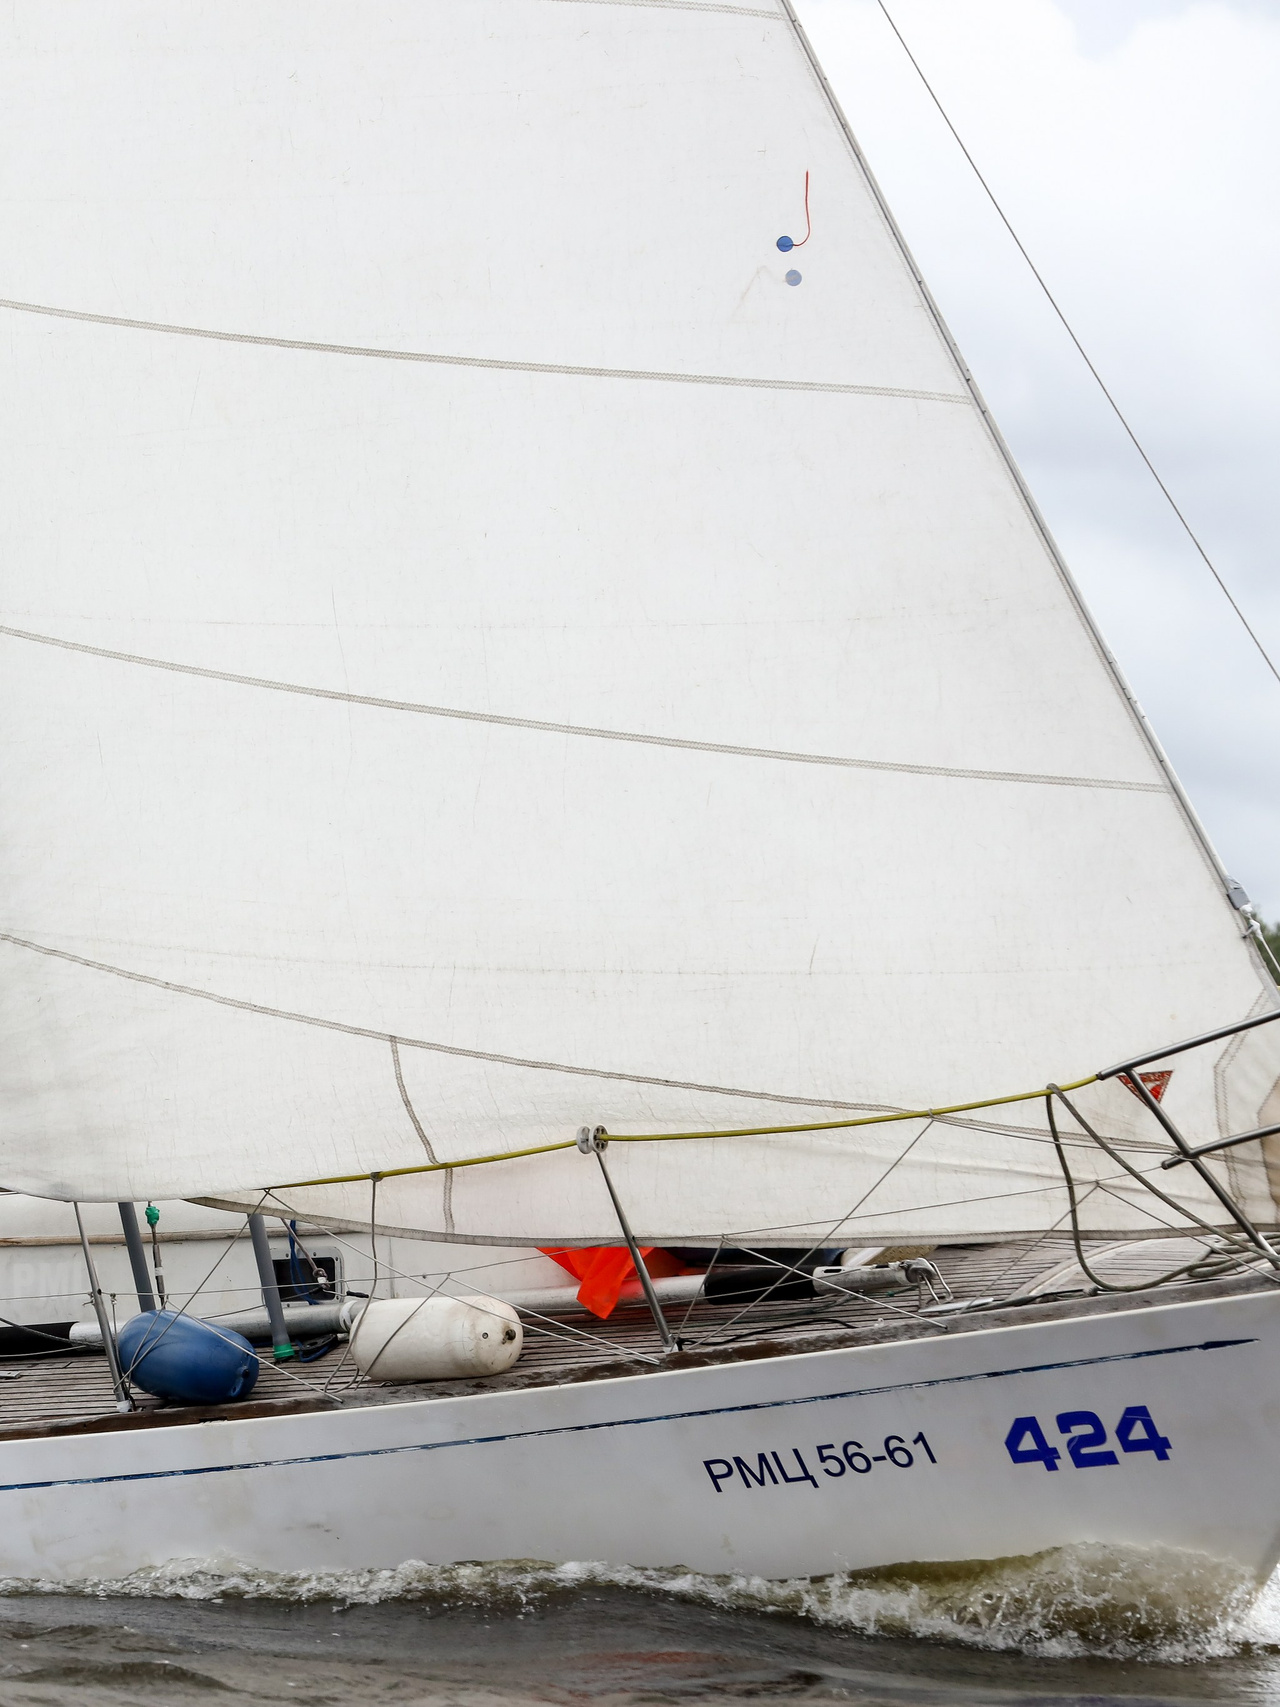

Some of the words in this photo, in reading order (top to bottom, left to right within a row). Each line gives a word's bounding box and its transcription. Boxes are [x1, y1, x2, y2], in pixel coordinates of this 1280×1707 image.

[702, 1447, 820, 1493] РМЦ
[817, 1431, 938, 1478] 56-61
[1003, 1404, 1173, 1472] 424
